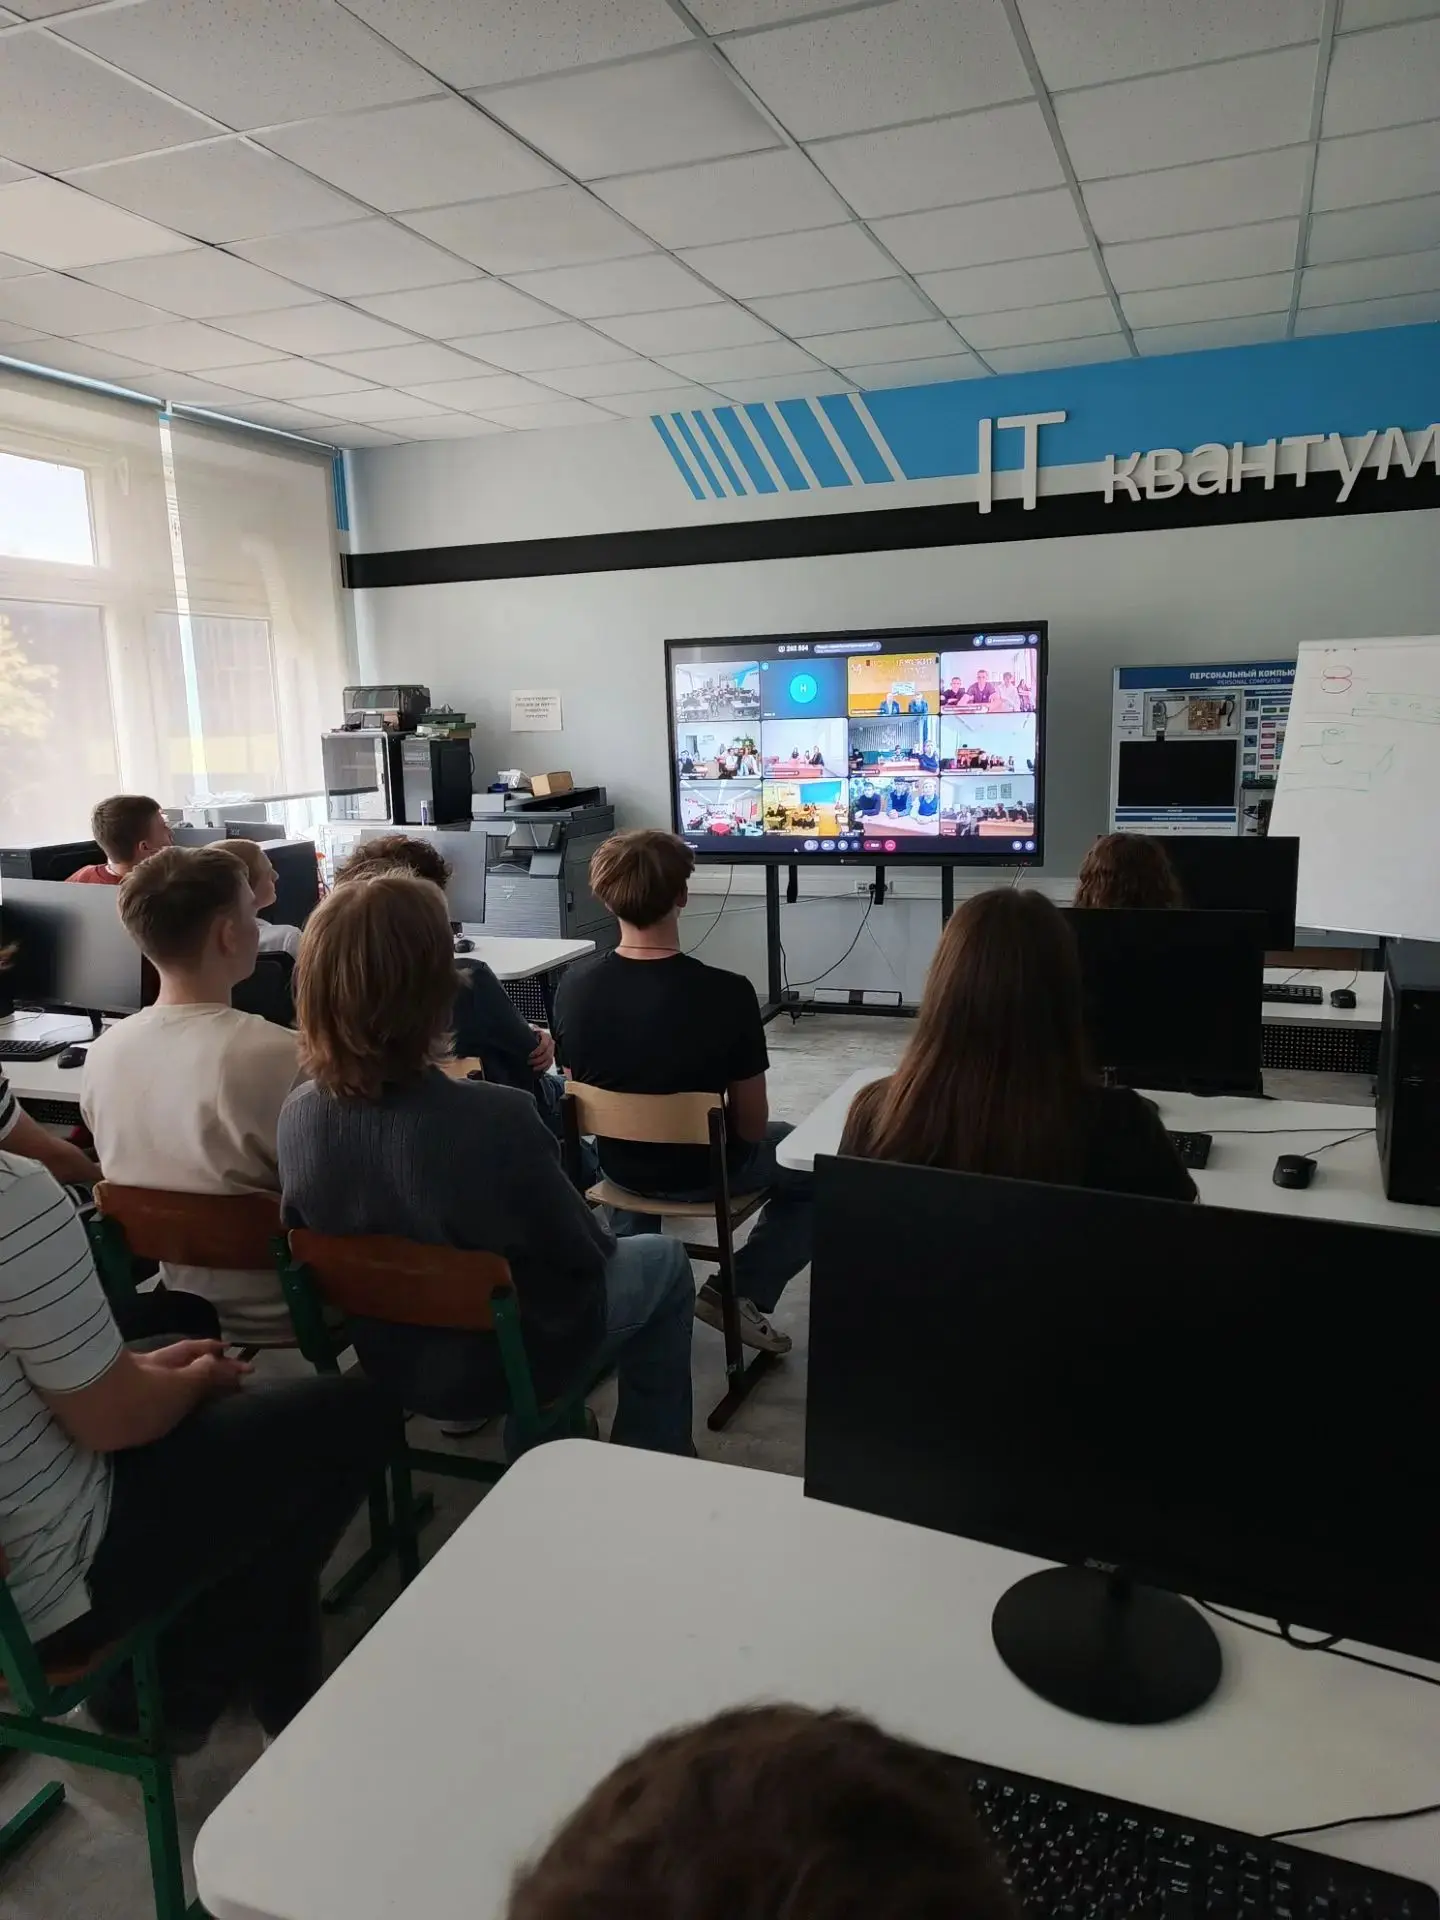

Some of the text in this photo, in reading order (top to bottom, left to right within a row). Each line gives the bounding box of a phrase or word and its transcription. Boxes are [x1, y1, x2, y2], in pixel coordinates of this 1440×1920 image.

[978, 411, 1068, 514] IT
[1104, 422, 1440, 503] квантум
[1190, 669, 1257, 680] ПЕРСОНАЛЬНЫЙ
